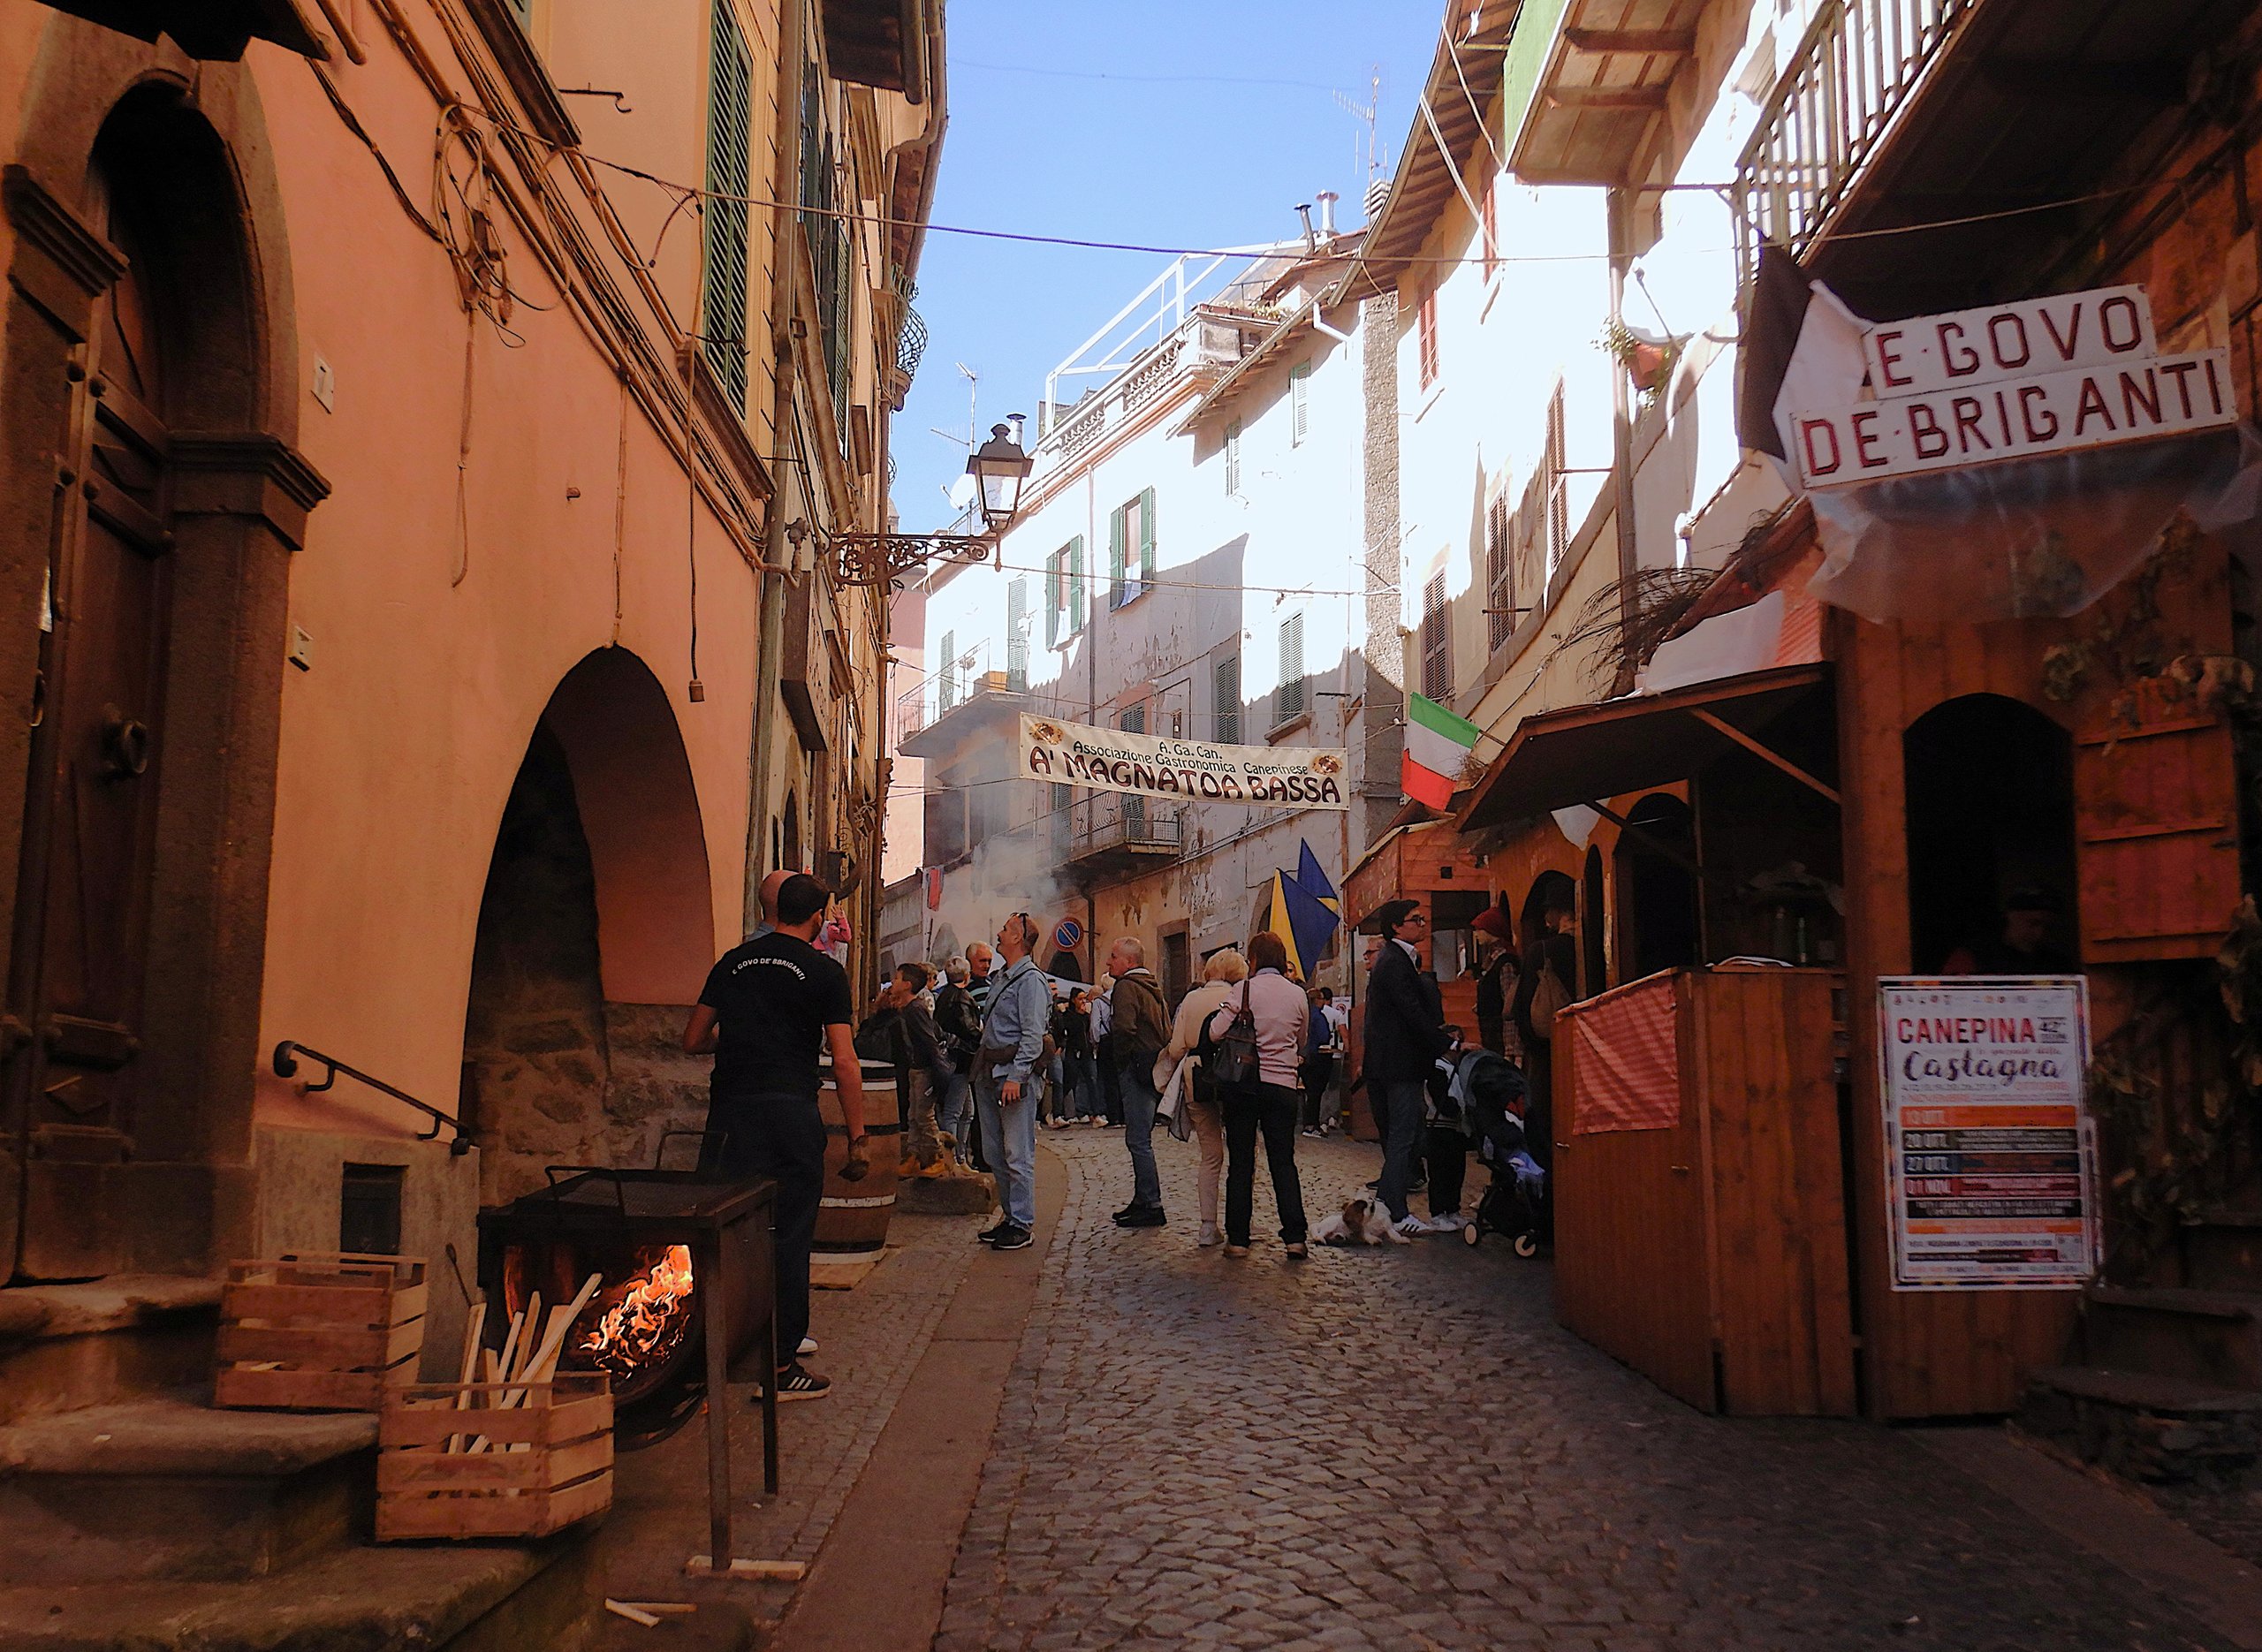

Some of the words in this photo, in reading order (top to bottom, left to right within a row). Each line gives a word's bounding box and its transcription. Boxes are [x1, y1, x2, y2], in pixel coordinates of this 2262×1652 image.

[1936, 295, 2142, 379] GOVO
[1907, 358, 2224, 461] BRIGANTI
[1073, 740, 1153, 765] Associazione
[1155, 752, 1237, 774] Gastronomica
[1242, 762, 1309, 777] Canepinese
[1159, 742, 1171, 754] A.
[1173, 743, 1195, 757] Ga.
[1196, 746, 1223, 760] Can.
[1061, 749, 1244, 799] MAGNATOA
[1246, 775, 1341, 804] BASSA
[737, 959, 759, 969] GOVO
[1897, 1017, 2037, 1044] CANEPINA
[1902, 1048, 2060, 1087] Castagna
